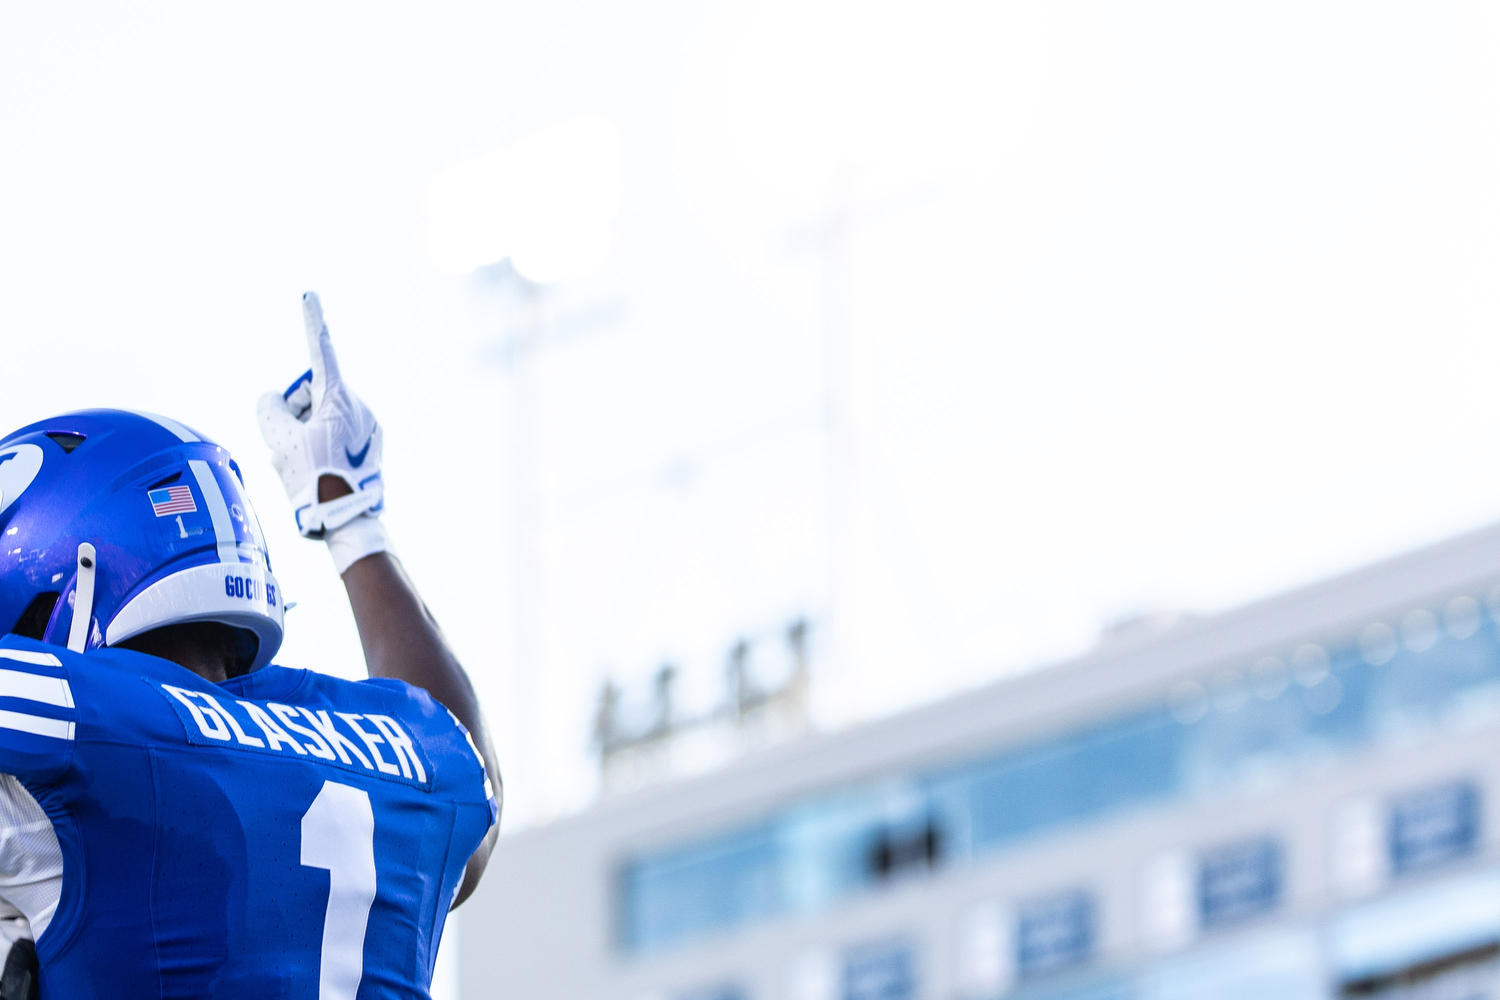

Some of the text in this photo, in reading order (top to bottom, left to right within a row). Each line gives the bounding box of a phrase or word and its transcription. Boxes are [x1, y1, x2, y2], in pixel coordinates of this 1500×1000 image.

[175, 515, 188, 539] 1
[225, 574, 244, 598] GO
[162, 684, 427, 783] GLASKER
